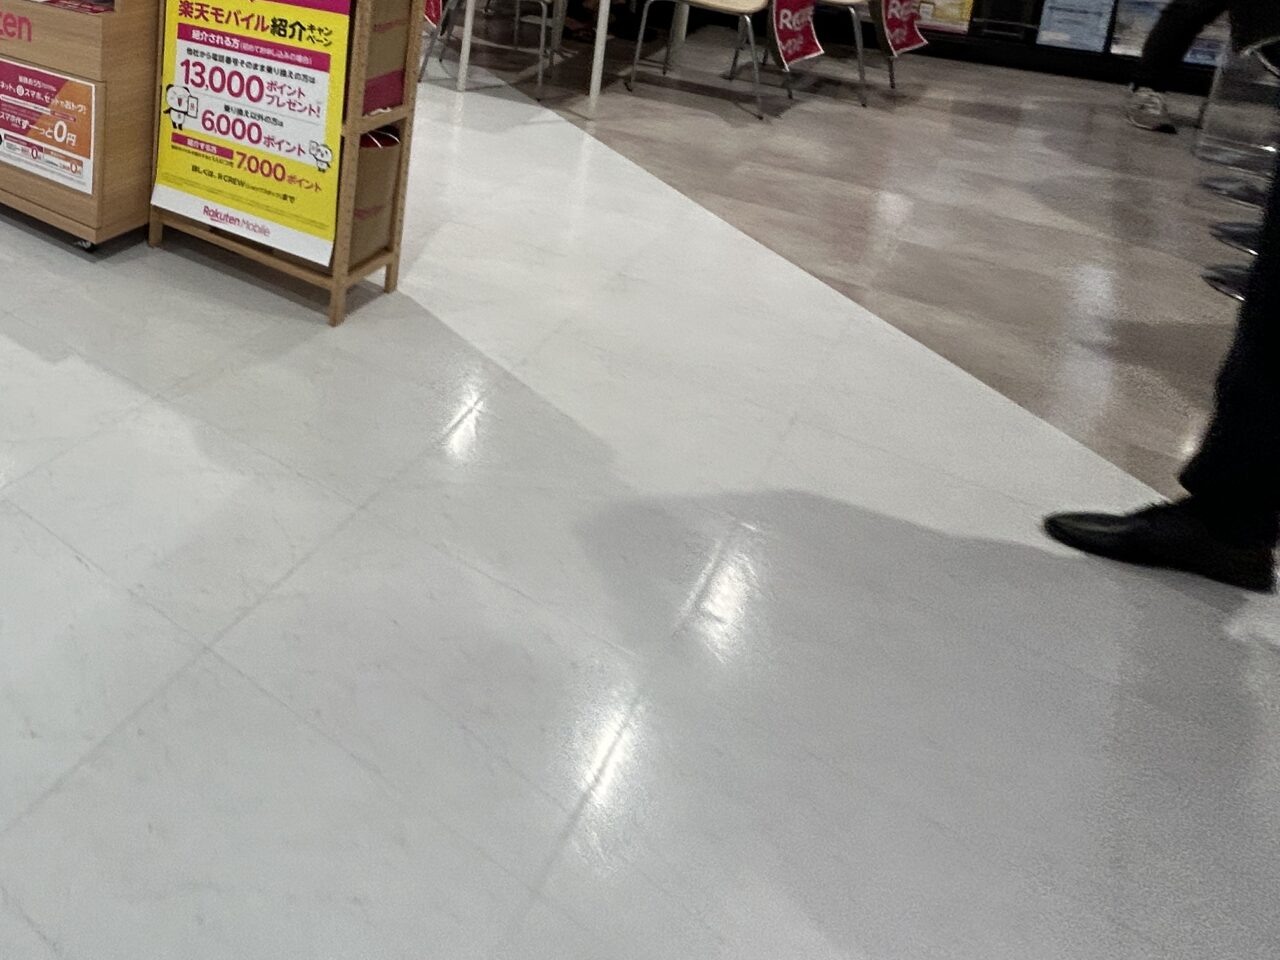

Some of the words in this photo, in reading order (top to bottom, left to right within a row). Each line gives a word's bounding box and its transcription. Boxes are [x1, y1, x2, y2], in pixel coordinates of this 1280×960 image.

[178, 0, 307, 42] 楽天モバイル紹介
[191, 29, 240, 49] 紹介される方
[180, 58, 264, 103] 13,000
[267, 81, 306, 98] ポイント
[266, 93, 320, 118] プレゼント!
[201, 109, 263, 145] 6,000
[263, 135, 306, 157] ポイント
[287, 175, 322, 192] ポイント
[203, 205, 240, 226] Rakuten
[240, 218, 271, 237] Mobile
